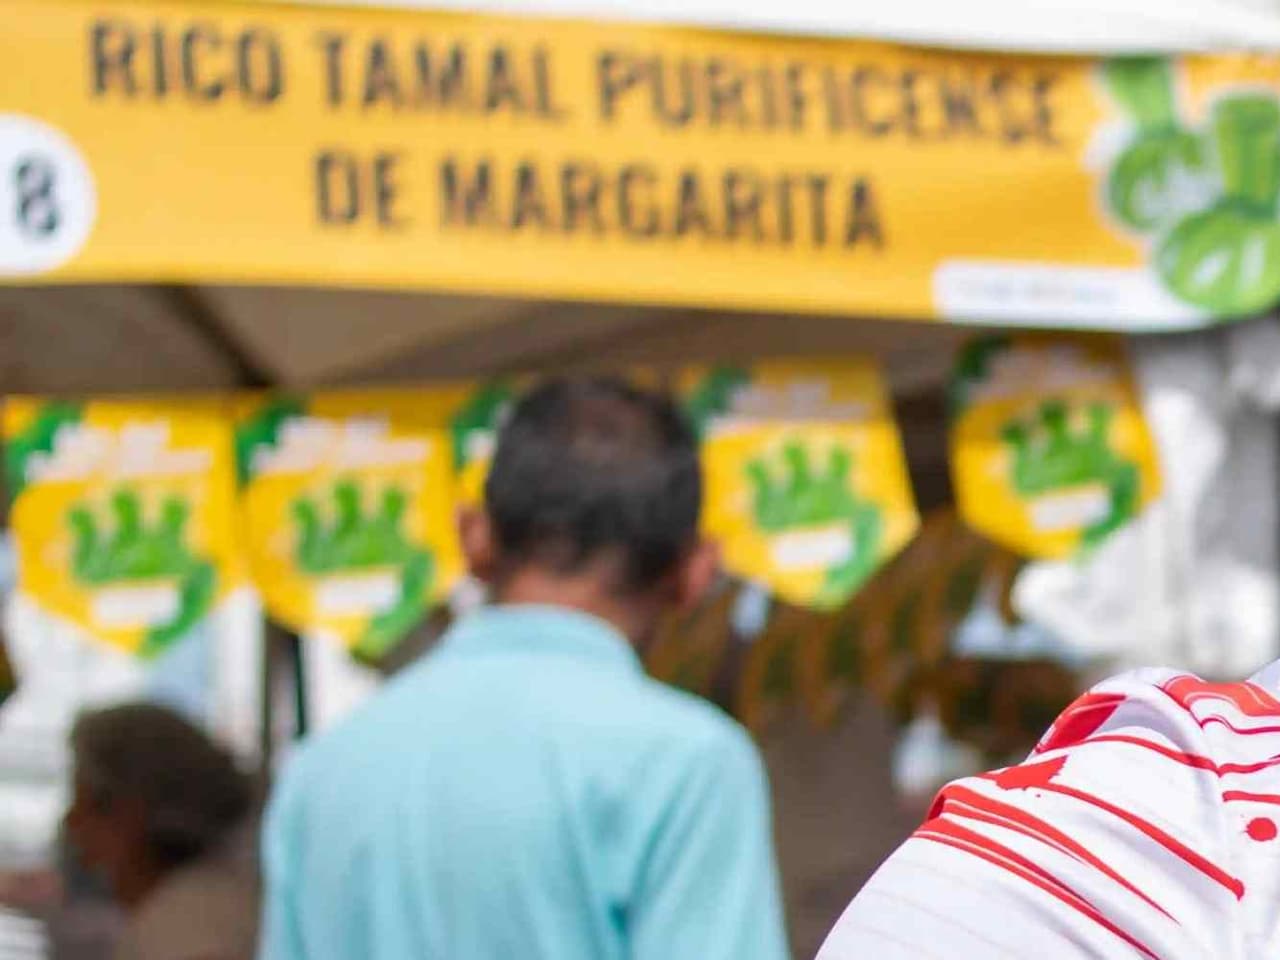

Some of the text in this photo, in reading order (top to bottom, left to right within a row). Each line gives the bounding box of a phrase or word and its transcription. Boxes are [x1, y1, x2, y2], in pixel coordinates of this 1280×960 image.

[90, 21, 1060, 147] RICO TAMAL PURIFICENSE
[13, 154, 60, 240] 8
[313, 148, 883, 250] DE MARGARITA
